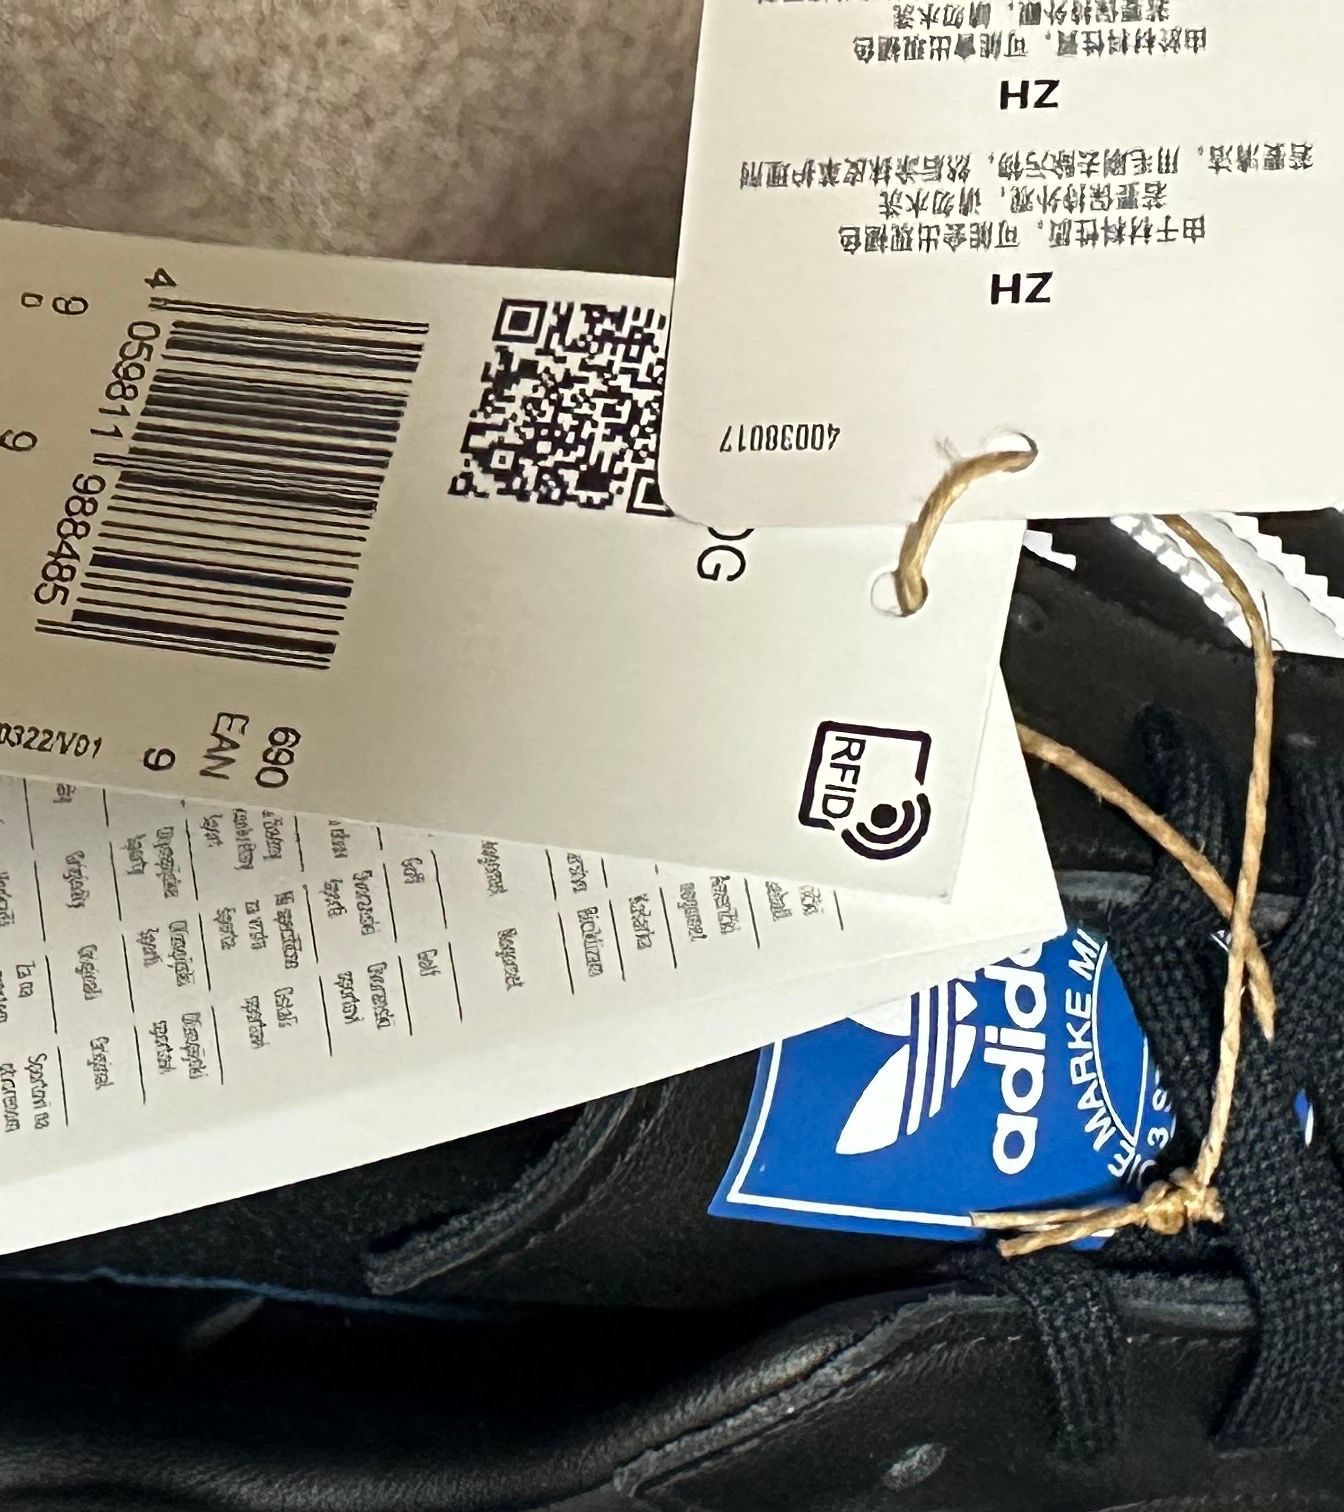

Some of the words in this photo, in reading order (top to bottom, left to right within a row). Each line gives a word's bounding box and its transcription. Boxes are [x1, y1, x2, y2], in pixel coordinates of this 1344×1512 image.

[1000, 80, 1060, 110] ZH
[144, 268, 178, 289] 4
[991, 272, 1053, 304] ZH
[52, 296, 88, 315] 9
[91, 321, 160, 442] 059811
[0, 429, 37, 452] 9
[720, 423, 840, 452] 40038017
[34, 474, 105, 605] 988485
[143, 748, 175, 771] 9
[200, 712, 249, 779] EAN
[255, 727, 301, 788] 690
[821, 735, 865, 818] RFID
